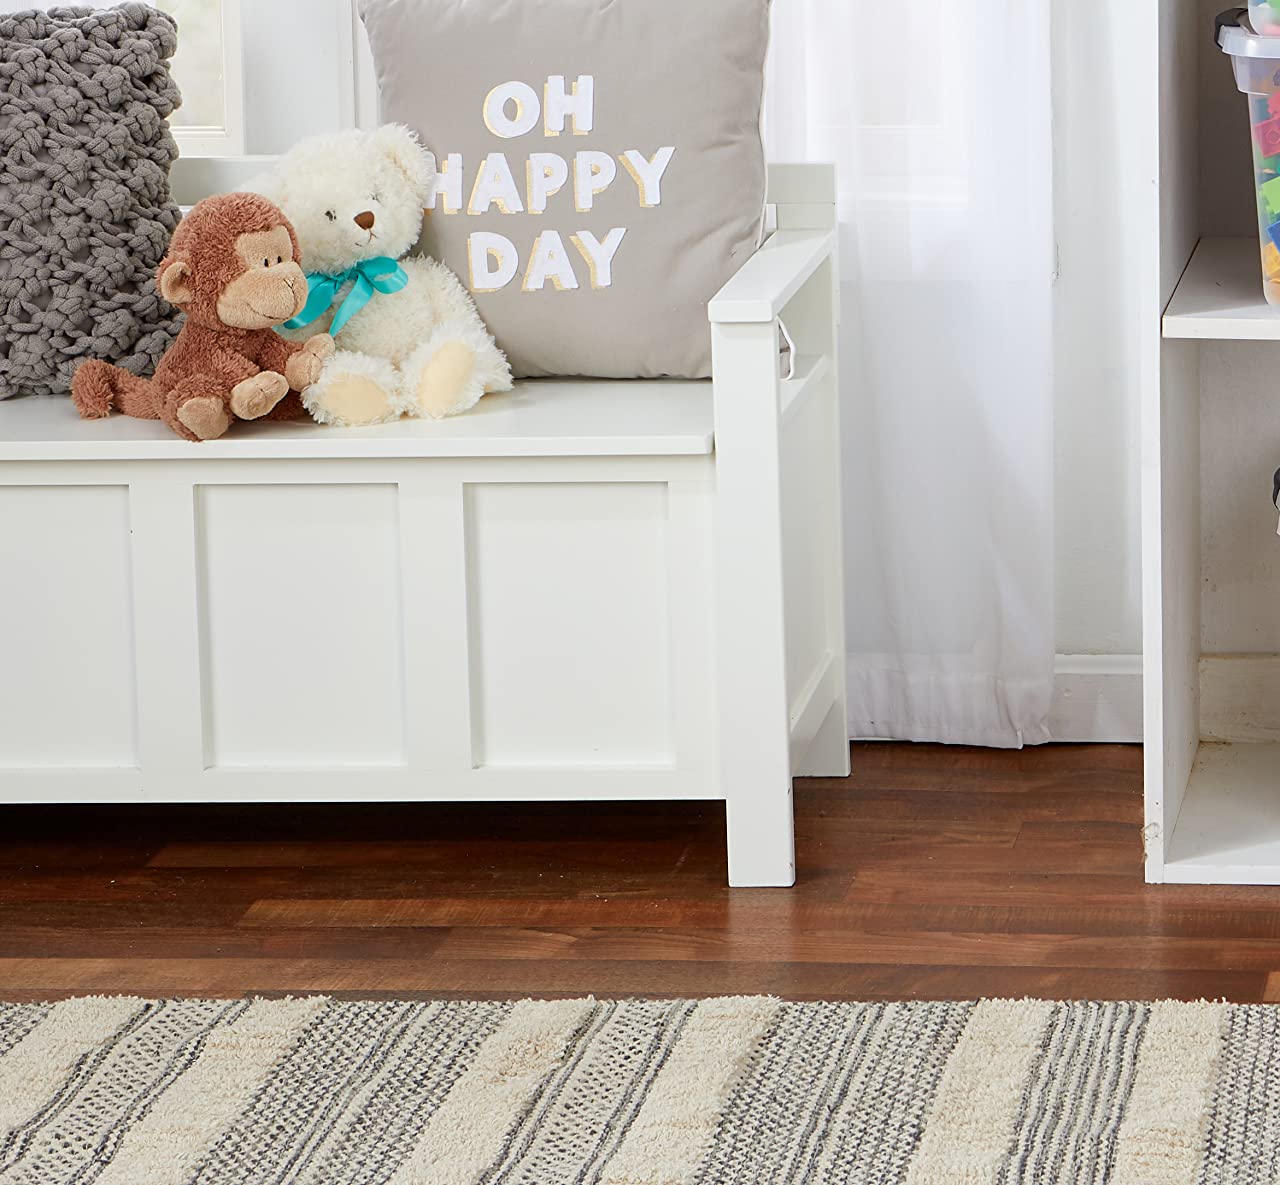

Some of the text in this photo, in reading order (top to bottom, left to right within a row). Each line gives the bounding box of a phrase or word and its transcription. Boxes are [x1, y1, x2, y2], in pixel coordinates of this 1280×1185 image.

[483, 75, 594, 138] OH
[423, 146, 676, 215] HAPPY
[467, 227, 627, 293] DAY
